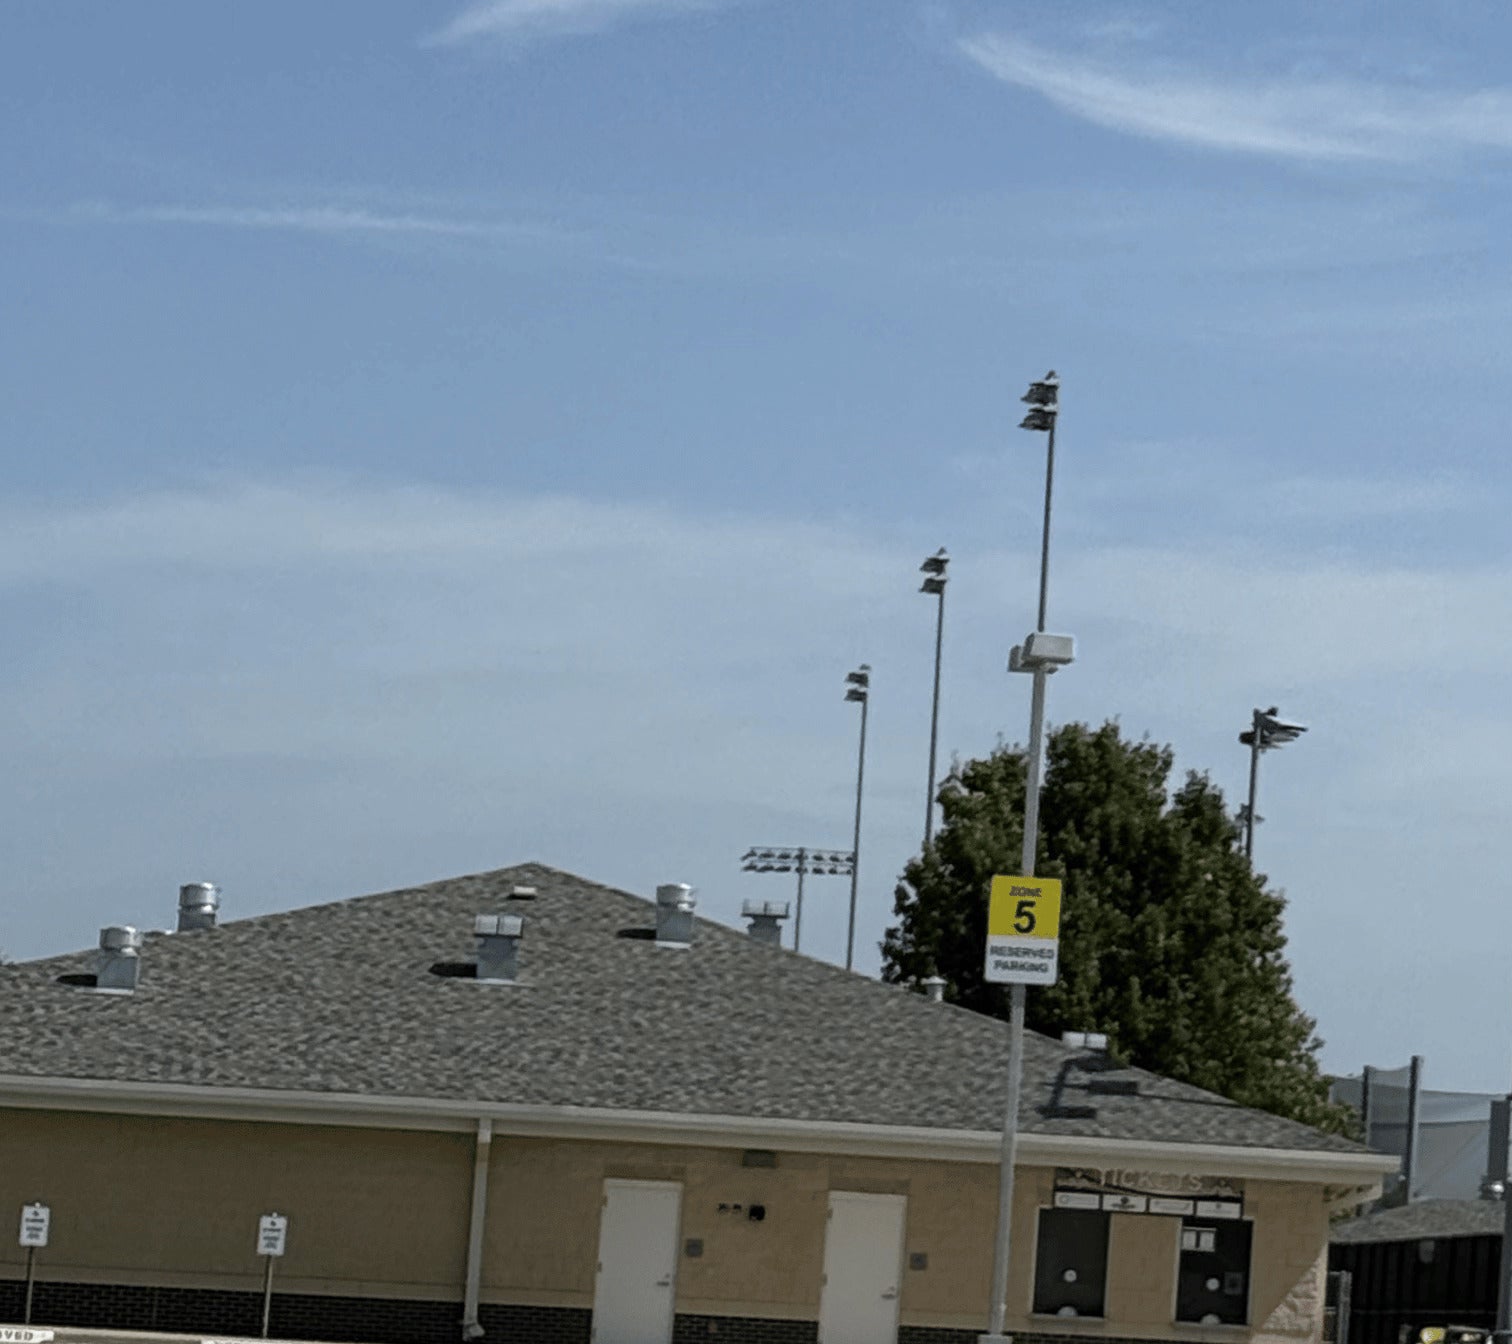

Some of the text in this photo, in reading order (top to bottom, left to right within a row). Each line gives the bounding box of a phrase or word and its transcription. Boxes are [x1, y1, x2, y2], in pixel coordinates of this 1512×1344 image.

[1013, 900, 1036, 934] 5
[1097, 1167, 1203, 1192] TICKETS
[0, 1329, 33, 1341] VED
